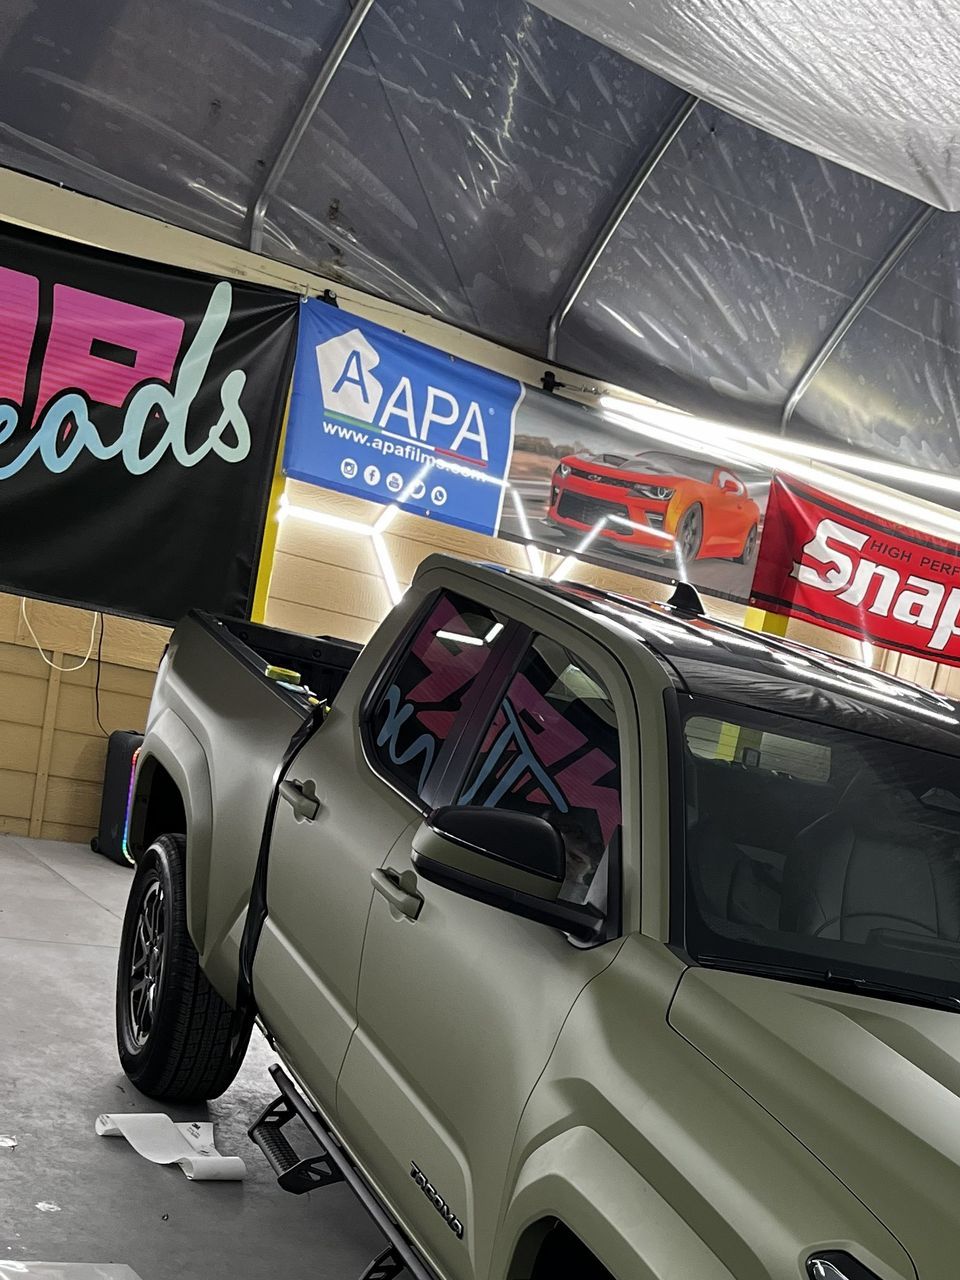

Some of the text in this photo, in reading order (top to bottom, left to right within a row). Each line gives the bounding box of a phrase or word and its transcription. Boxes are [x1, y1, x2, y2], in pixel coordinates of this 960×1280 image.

[379, 376, 489, 462] APA
[869, 539, 913, 563] HIGH
[410, 1160, 464, 1240] TACOMA
